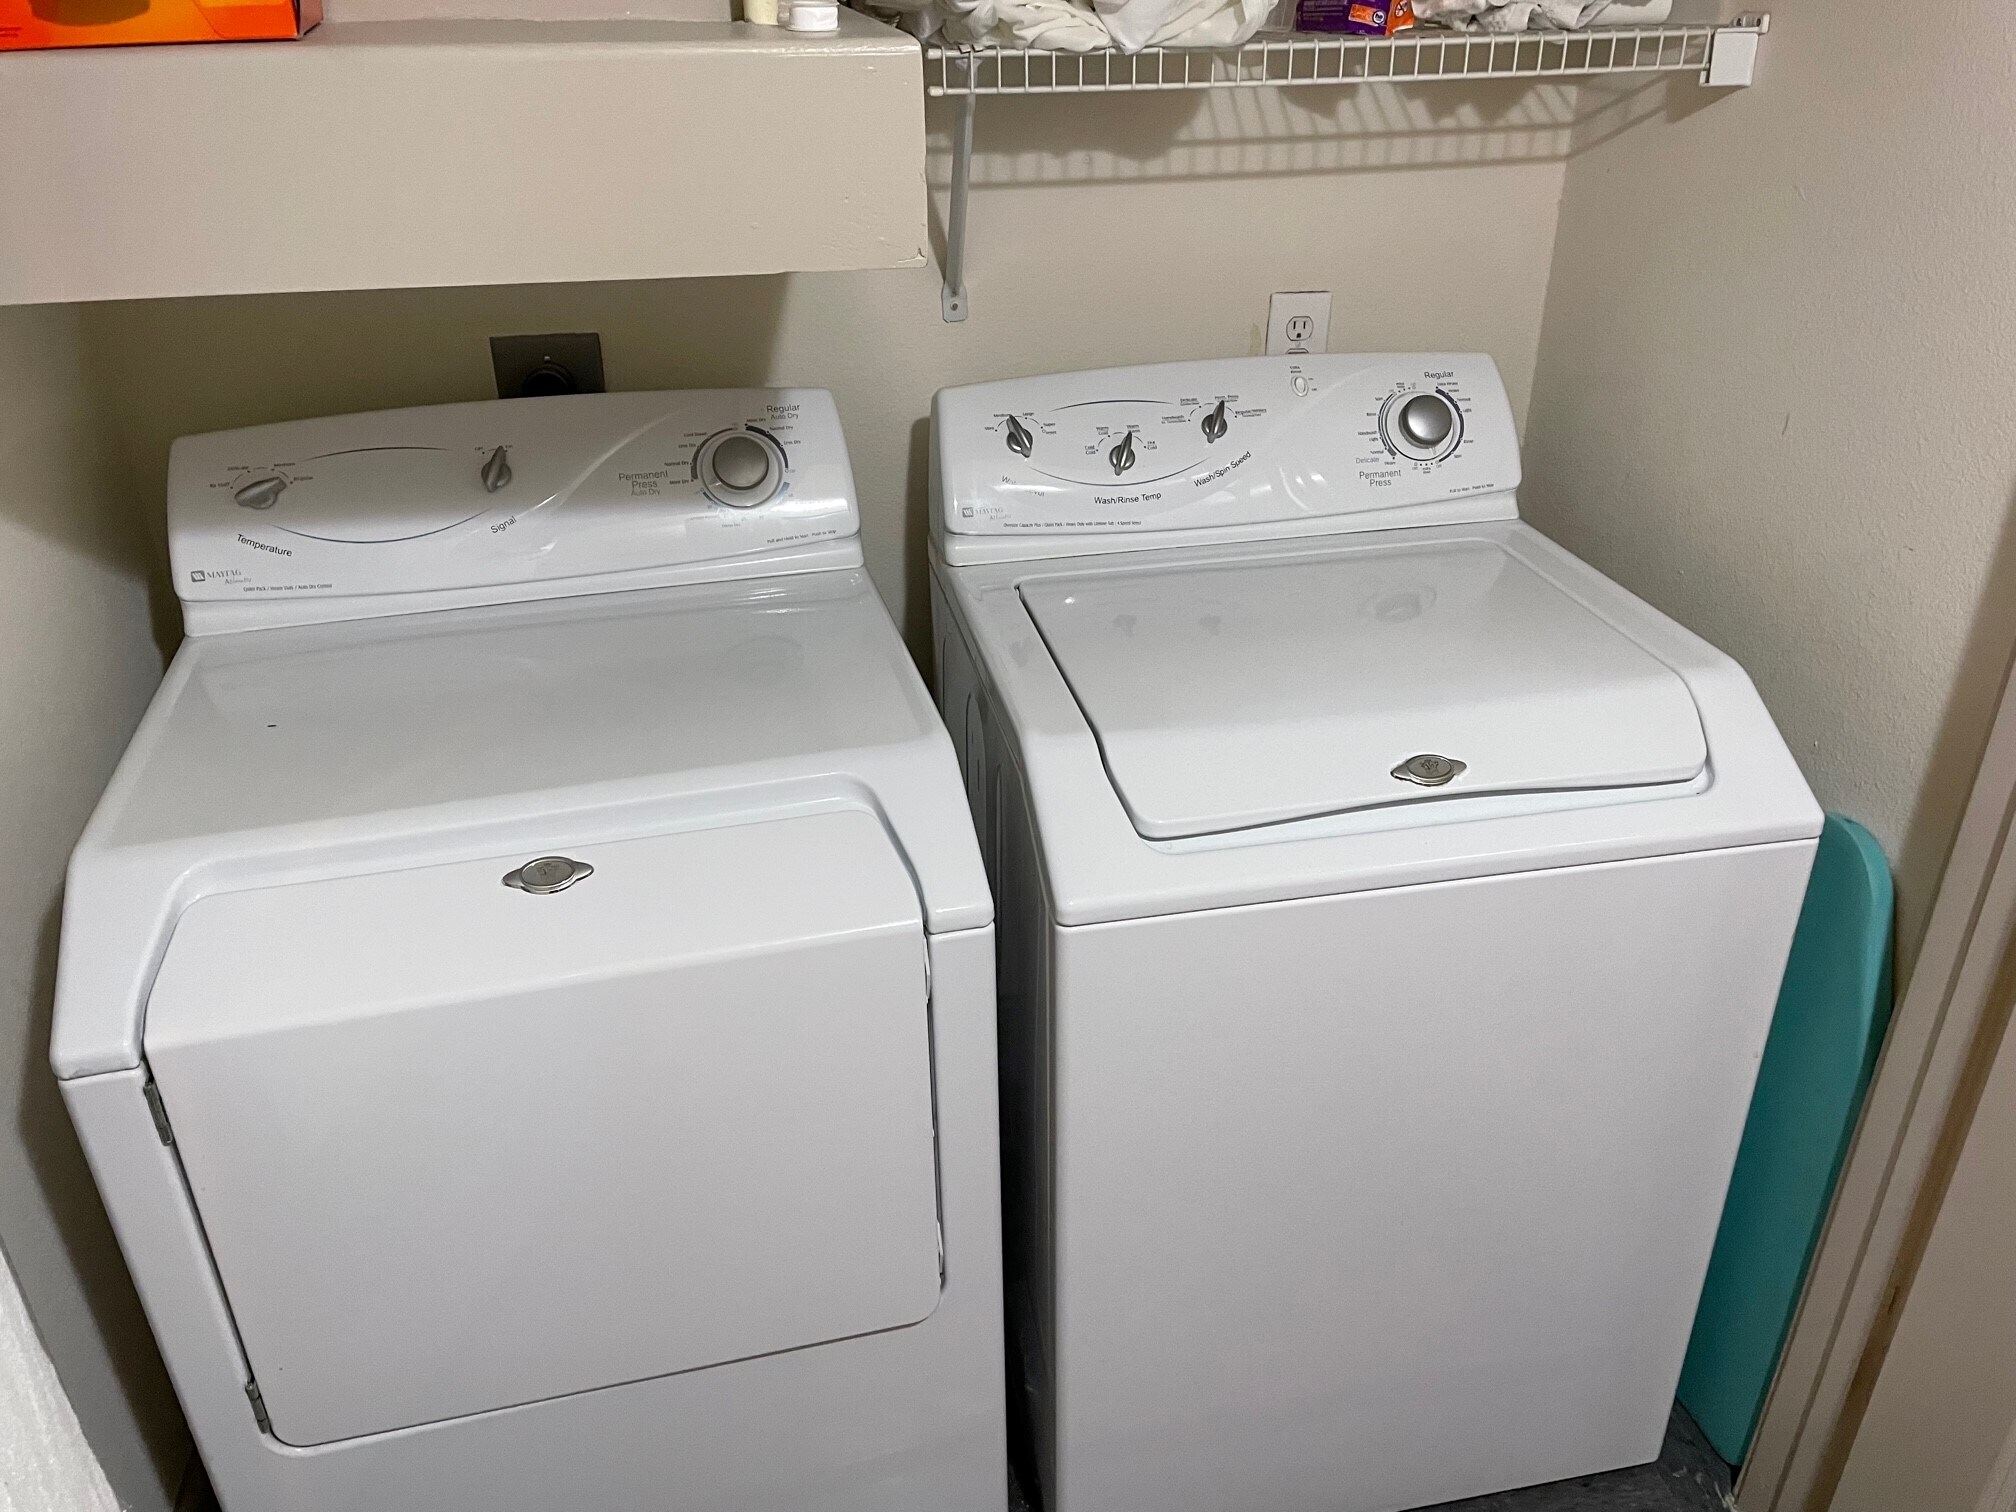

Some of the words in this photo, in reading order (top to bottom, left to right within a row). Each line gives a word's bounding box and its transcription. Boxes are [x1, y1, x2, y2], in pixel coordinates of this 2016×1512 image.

[1424, 371, 1454, 379] Regular
[766, 403, 801, 414] Regular
[787, 412, 799, 420] Dry
[1193, 465, 1231, 487] Wash/Spin
[1229, 450, 1252, 469] Speed
[618, 470, 669, 481] Permanent
[1359, 470, 1402, 480] Permanent
[631, 480, 658, 489] Press
[1369, 479, 1392, 487] Press
[648, 488, 661, 496] Dry
[1094, 495, 1139, 505] Wash/Rinse
[1141, 492, 1162, 502] Temp
[974, 507, 1004, 515] MAYTAG
[490, 515, 517, 533] Signal
[236, 533, 293, 557] Temperature
[206, 569, 242, 579] MAYTAG
